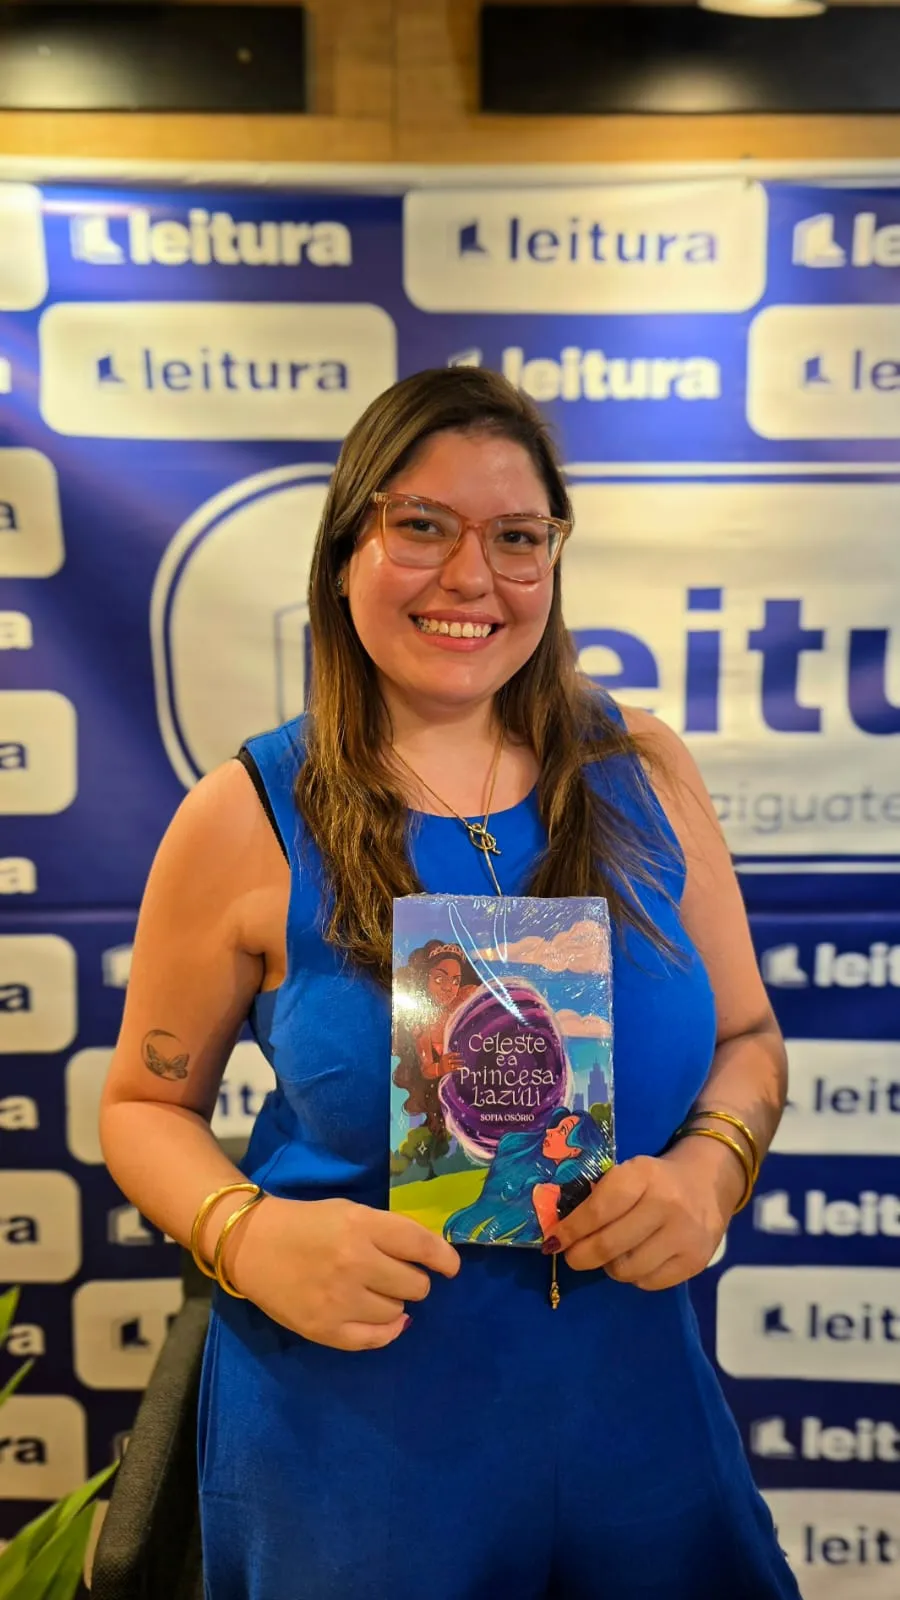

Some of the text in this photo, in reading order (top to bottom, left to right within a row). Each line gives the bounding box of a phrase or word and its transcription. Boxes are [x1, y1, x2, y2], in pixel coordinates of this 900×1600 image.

[127, 208, 353, 266] leitura
[509, 216, 719, 264] leitura
[143, 349, 349, 392] leitura
[502, 346, 721, 401] leitura
[468, 1032, 547, 1055] Celeste
[496, 1055, 518, 1066] e a
[457, 1066, 555, 1086] Princesa
[480, 1112, 535, 1122] SOFIA OSÓRIO
[804, 1525, 893, 1565] leit
